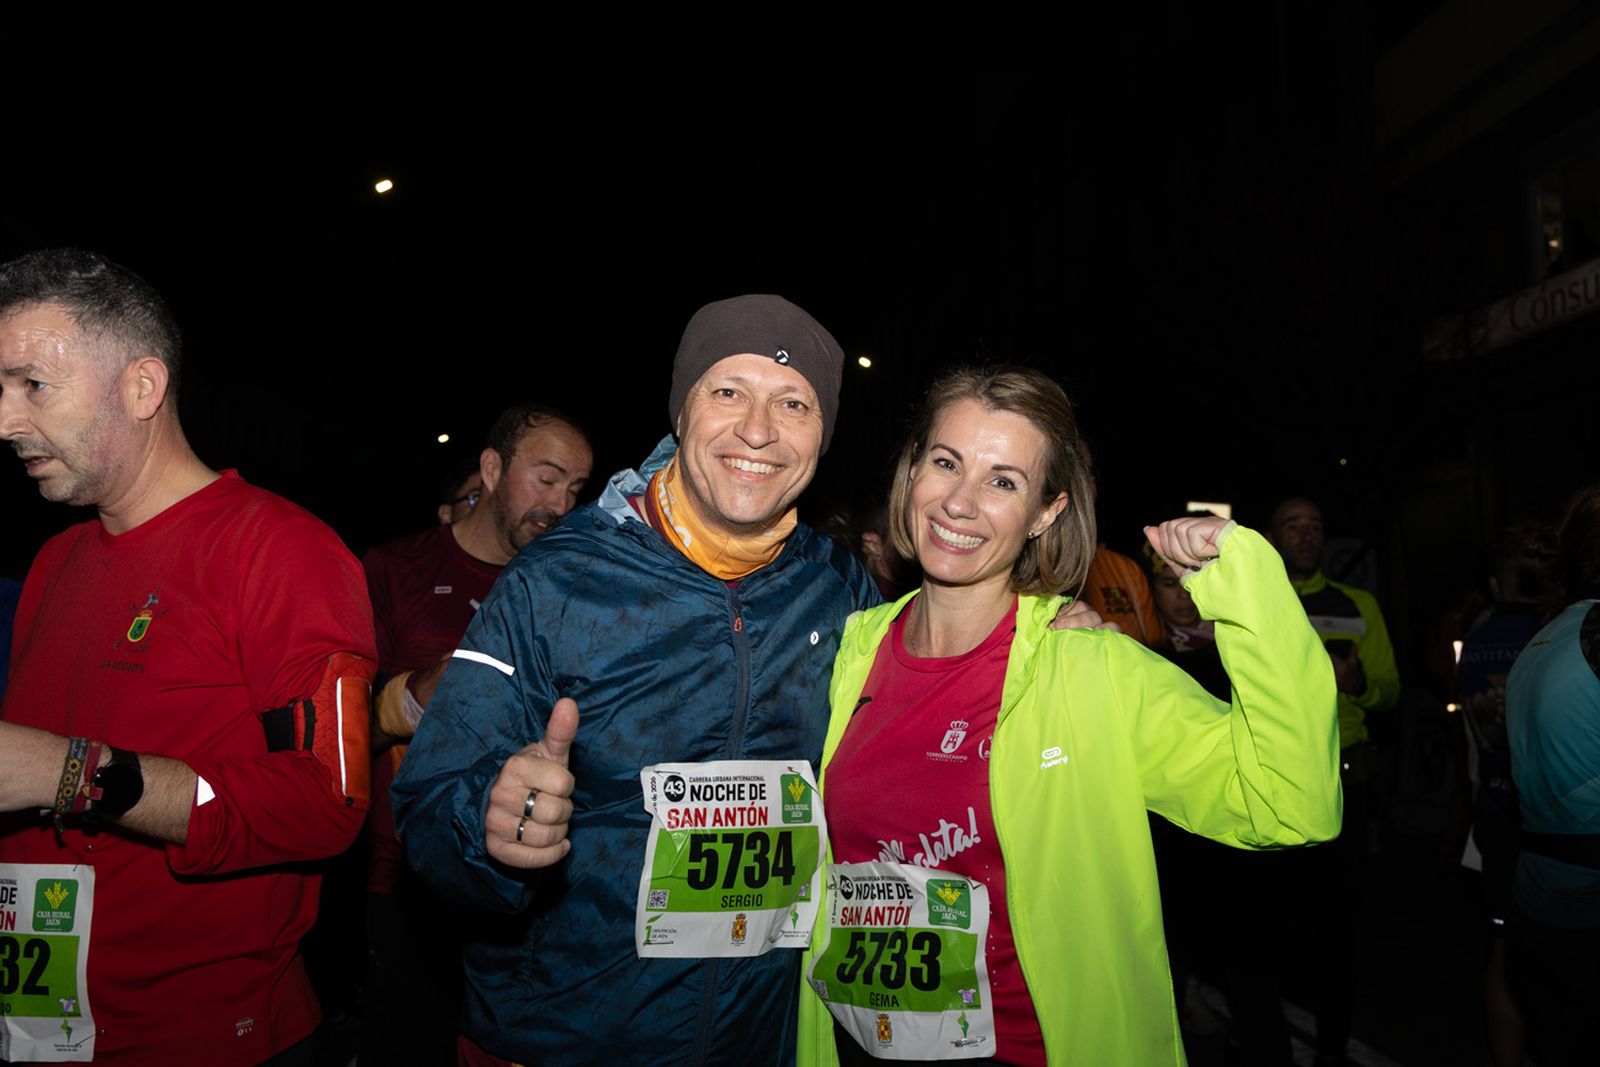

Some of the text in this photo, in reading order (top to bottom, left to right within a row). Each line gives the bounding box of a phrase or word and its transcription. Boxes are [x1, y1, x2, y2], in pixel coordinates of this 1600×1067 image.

[665, 780, 684, 797] 43
[690, 783, 767, 801] NOCHE DE
[667, 808, 708, 829] SAN
[712, 802, 768, 827] ANTÓN
[687, 830, 796, 890] 5734
[0, 887, 18, 905] DE
[855, 883, 914, 900] NOCHE DE
[720, 893, 763, 909] SERGIO
[840, 901, 912, 926] SAN ANTÓN
[0, 936, 50, 996] 32
[836, 930, 942, 991] 5733
[869, 991, 900, 1007] GEMA
